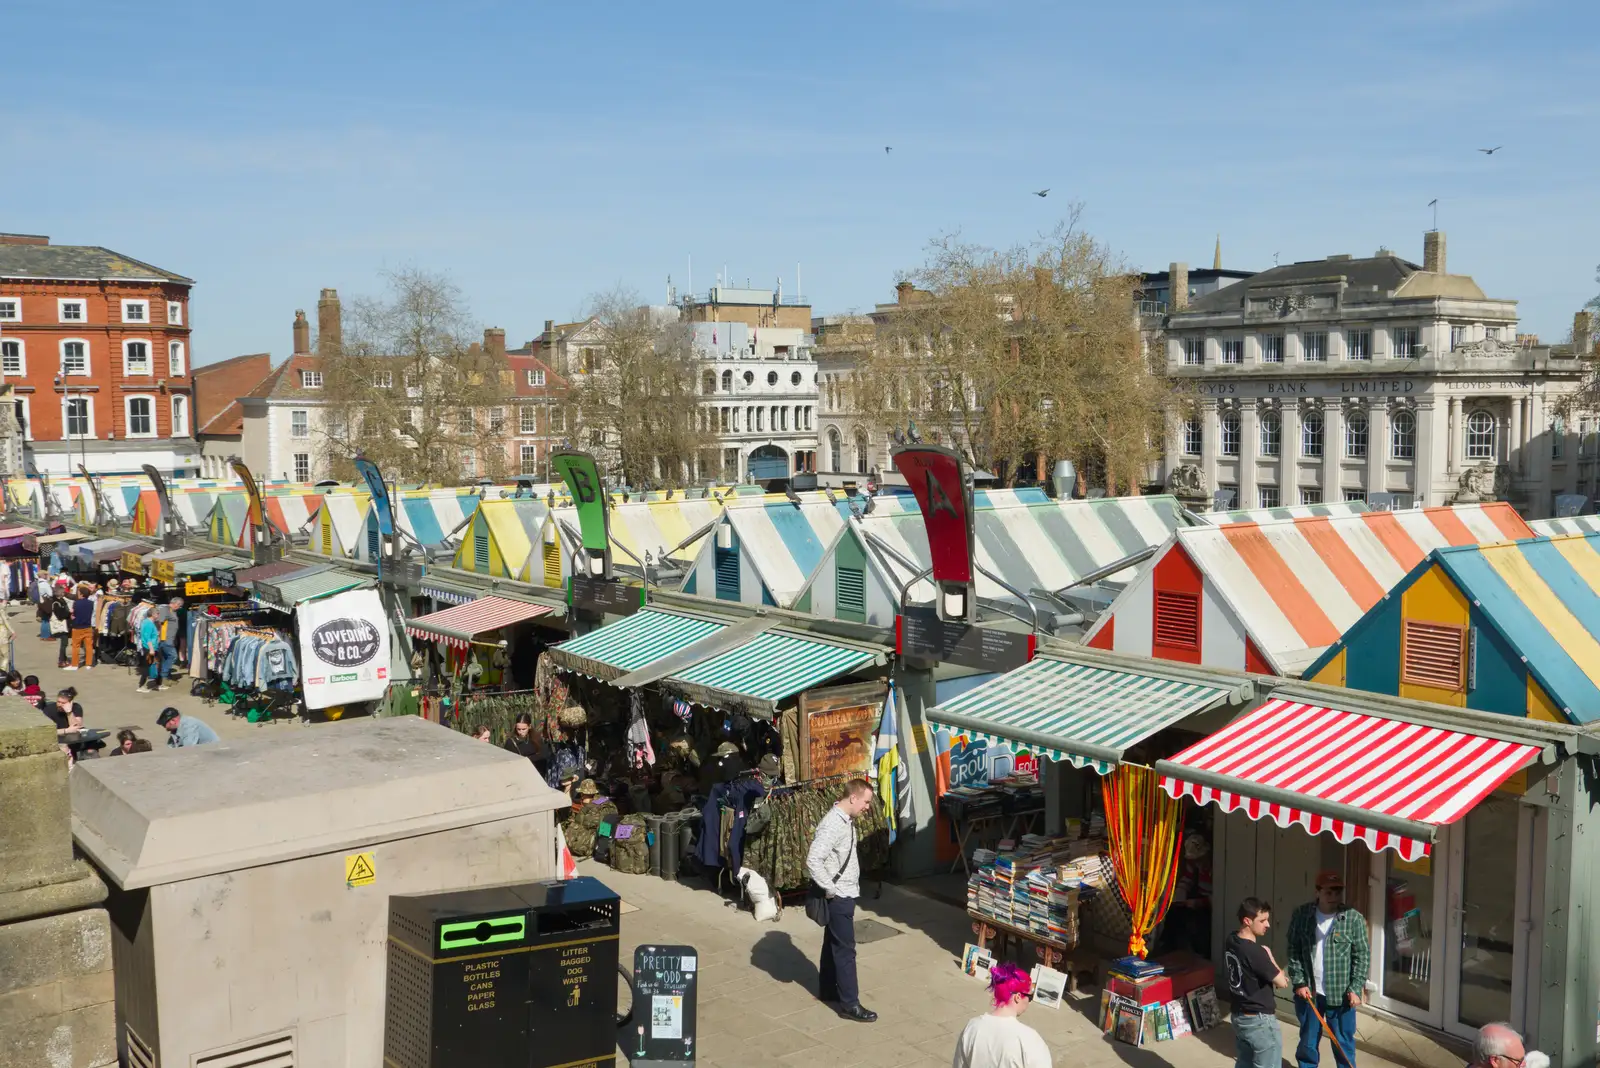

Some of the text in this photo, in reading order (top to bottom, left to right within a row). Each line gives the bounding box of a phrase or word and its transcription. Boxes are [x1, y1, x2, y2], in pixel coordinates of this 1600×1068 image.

[1197, 380, 1414, 395] OYDS BANK LIMITED
[1447, 380, 1530, 390] LLOYDS BANK
[568, 467, 596, 503] B
[925, 469, 958, 519] A
[337, 646, 346, 660] &
[331, 674, 357, 683] Barbour
[810, 707, 883, 728] COMBAT ZONE
[1549, 794, 1561, 805] 17
[562, 946, 589, 957] LITTER
[465, 960, 500, 972] PLASTIC
[560, 956, 592, 967] BAGGED
[643, 955, 681, 970] PRETTY
[463, 970, 501, 982] BOTTLES
[566, 967, 583, 976] DOG
[663, 970, 681, 984] ODD
[470, 981, 494, 991] CANS
[562, 975, 588, 986] WASTE
[467, 991, 496, 1002] PAPER
[467, 1000, 496, 1012] GLASS
